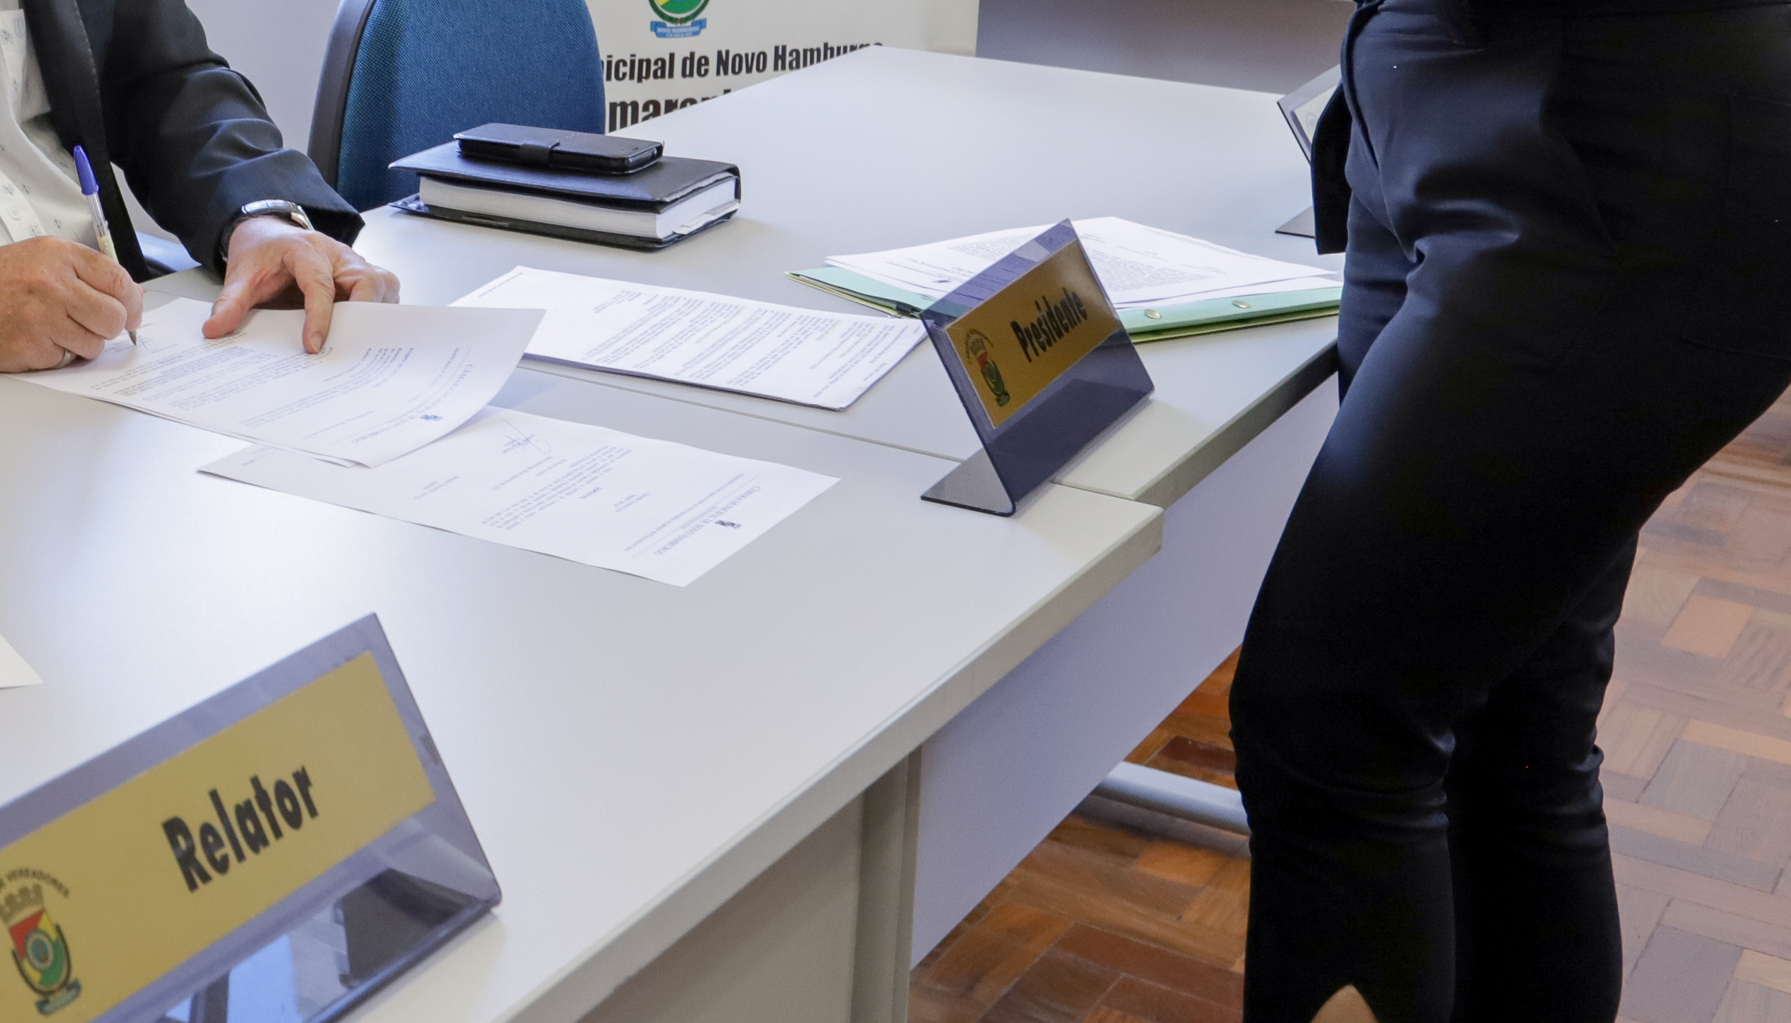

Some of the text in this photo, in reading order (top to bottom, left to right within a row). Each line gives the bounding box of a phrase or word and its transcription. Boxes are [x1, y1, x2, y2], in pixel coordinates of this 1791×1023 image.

[602, 42, 884, 83] icipal de Novo Hamb
[1010, 287, 1088, 363] Presidente
[161, 766, 320, 893] Relator
